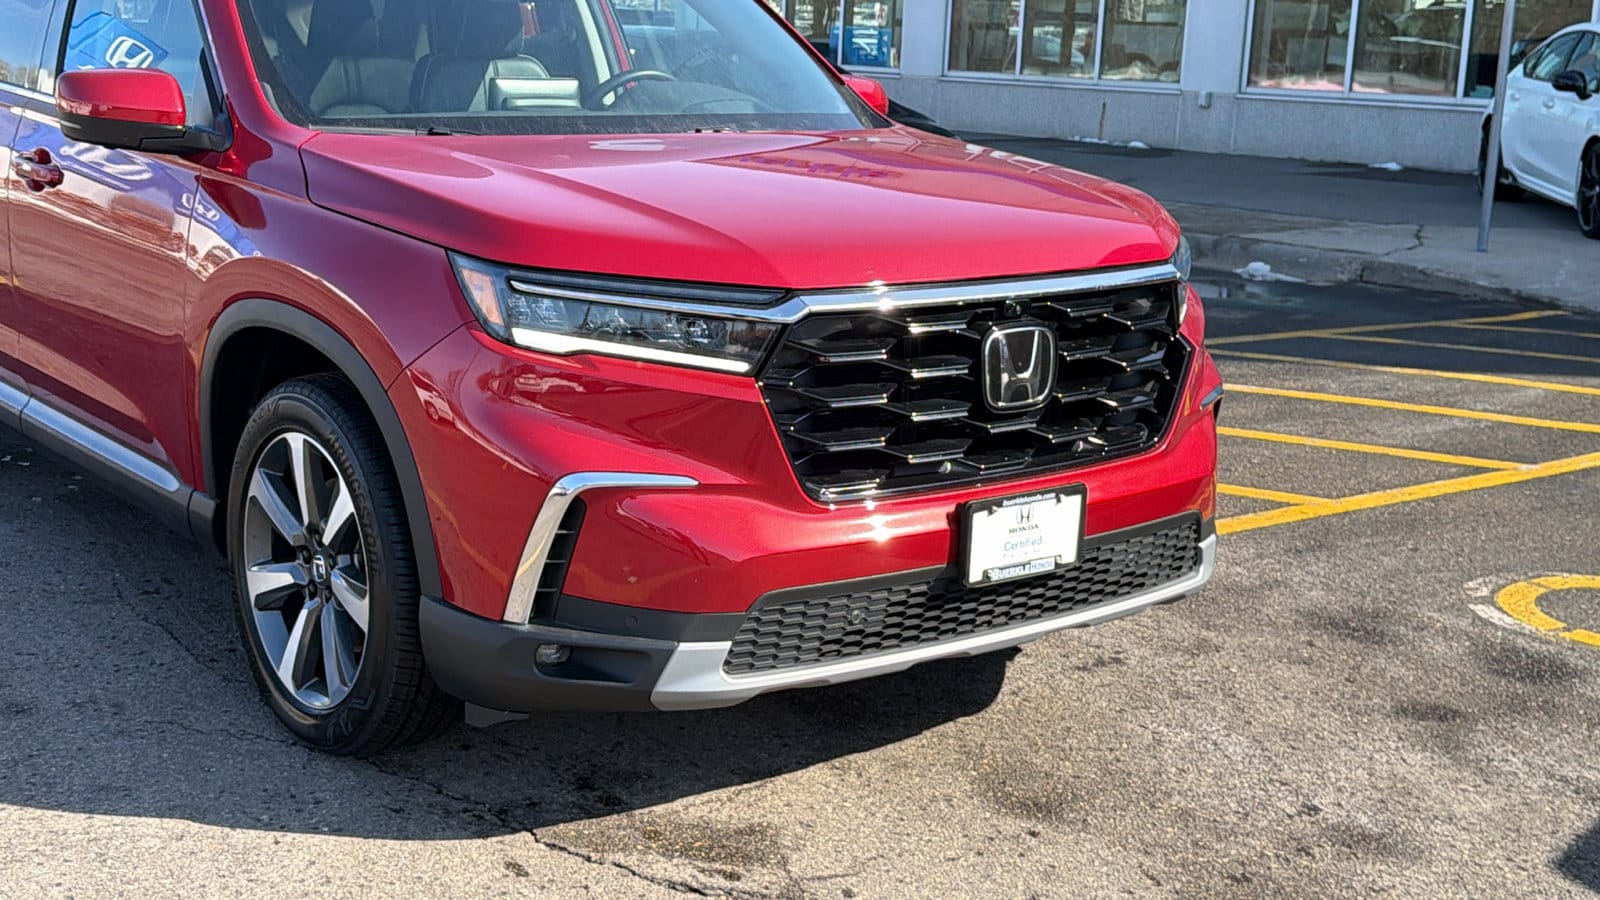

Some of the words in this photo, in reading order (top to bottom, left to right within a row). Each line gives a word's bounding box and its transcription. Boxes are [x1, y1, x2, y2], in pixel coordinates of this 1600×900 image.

[1008, 523, 1040, 534] HONDA
[1003, 534, 1043, 552] Certified
[991, 563, 1031, 579] BUERKLE
